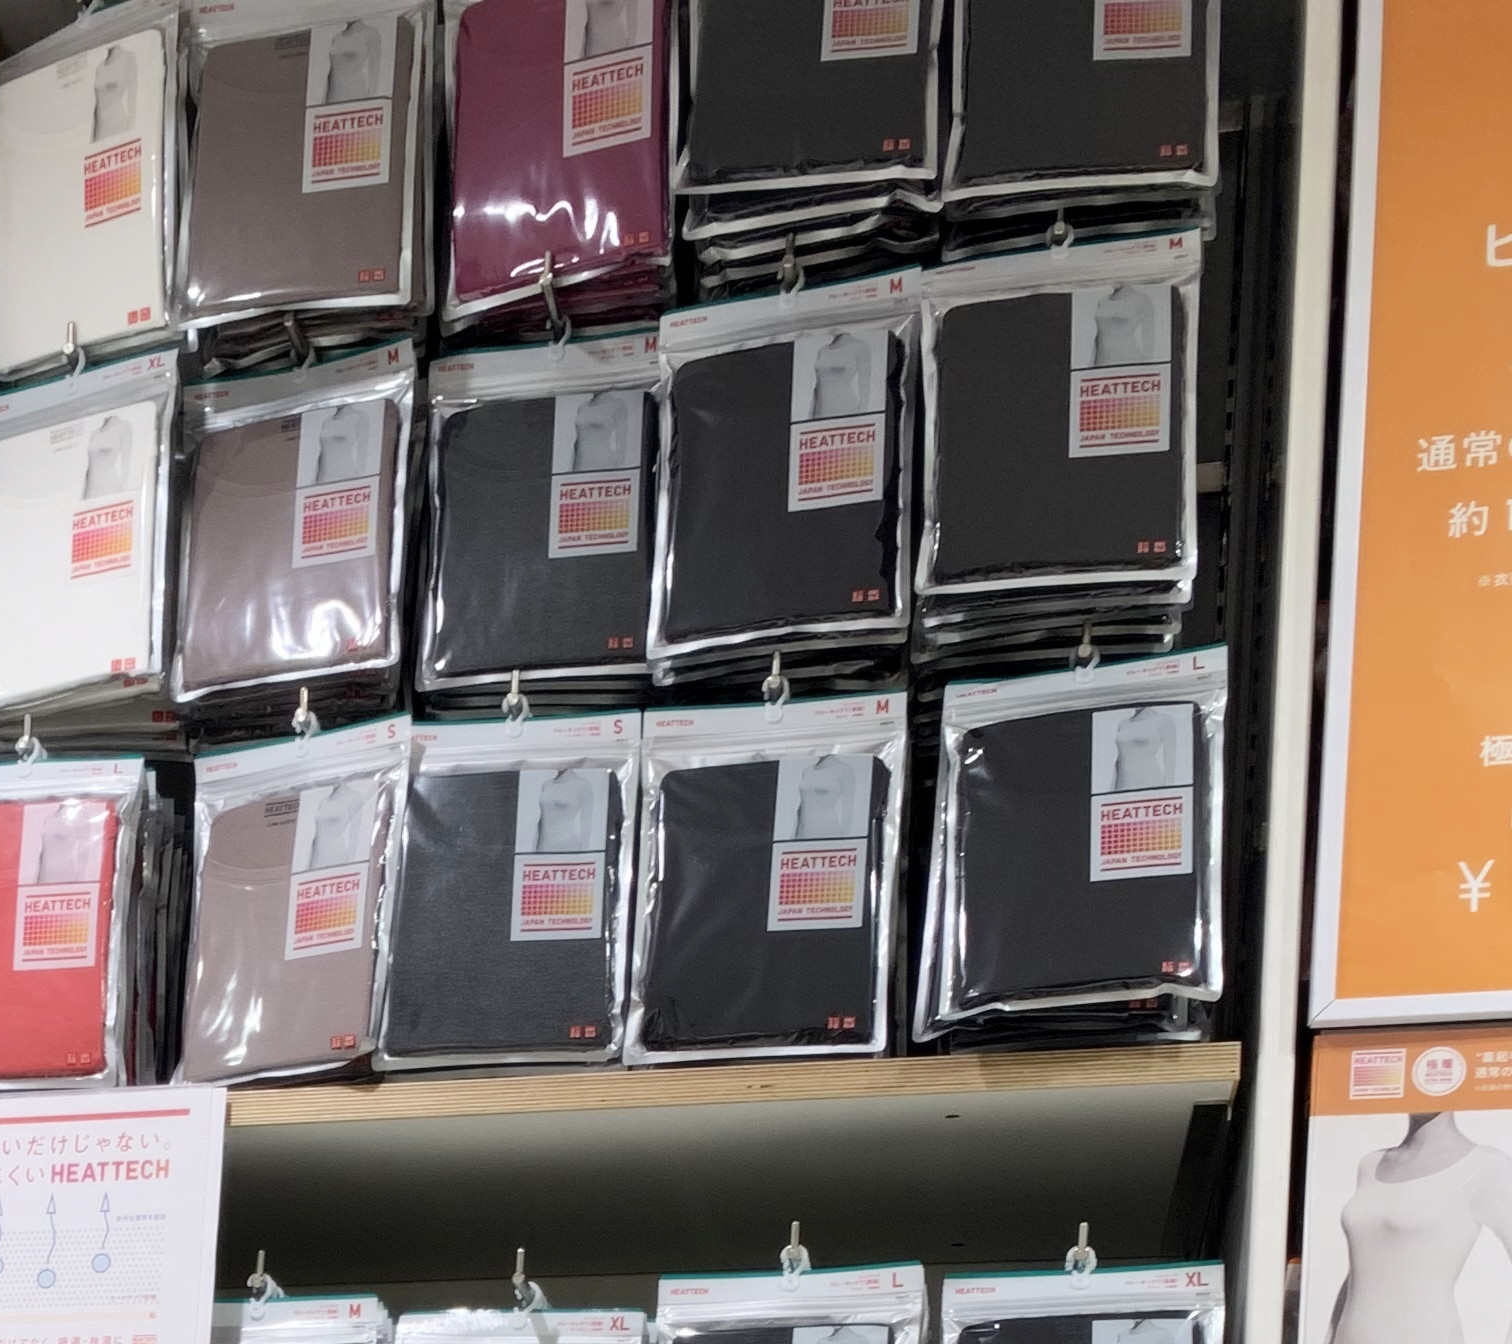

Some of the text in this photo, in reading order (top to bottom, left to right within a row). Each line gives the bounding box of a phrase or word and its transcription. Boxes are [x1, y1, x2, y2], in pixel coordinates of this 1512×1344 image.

[571, 65, 643, 91] HEATTECH
[313, 113, 384, 135] HEATTECH
[1170, 237, 1183, 249] M
[890, 277, 902, 294] M
[148, 355, 164, 370] XL
[388, 350, 399, 364] M
[1079, 377, 1161, 397] HEATTECH
[799, 428, 875, 450] HEATTECH
[1416, 429, 1512, 473] 通常
[560, 481, 631, 499] HEATTECH
[303, 491, 371, 512] HEATTECH
[72, 505, 133, 530] HEATTECH
[1193, 656, 1205, 671] L
[876, 700, 889, 714] M
[613, 720, 623, 735] S
[1101, 802, 1183, 821] HEATTECH
[780, 855, 857, 871] HEATTECH
[523, 867, 596, 883] HEATTECH
[297, 878, 360, 900] HEATTECH
[24, 897, 91, 913] HEATTECH
[892, 1273, 903, 1287] L
[1186, 1272, 1208, 1287] XL
[349, 1304, 361, 1318] M
[610, 1316, 630, 1331] XL
